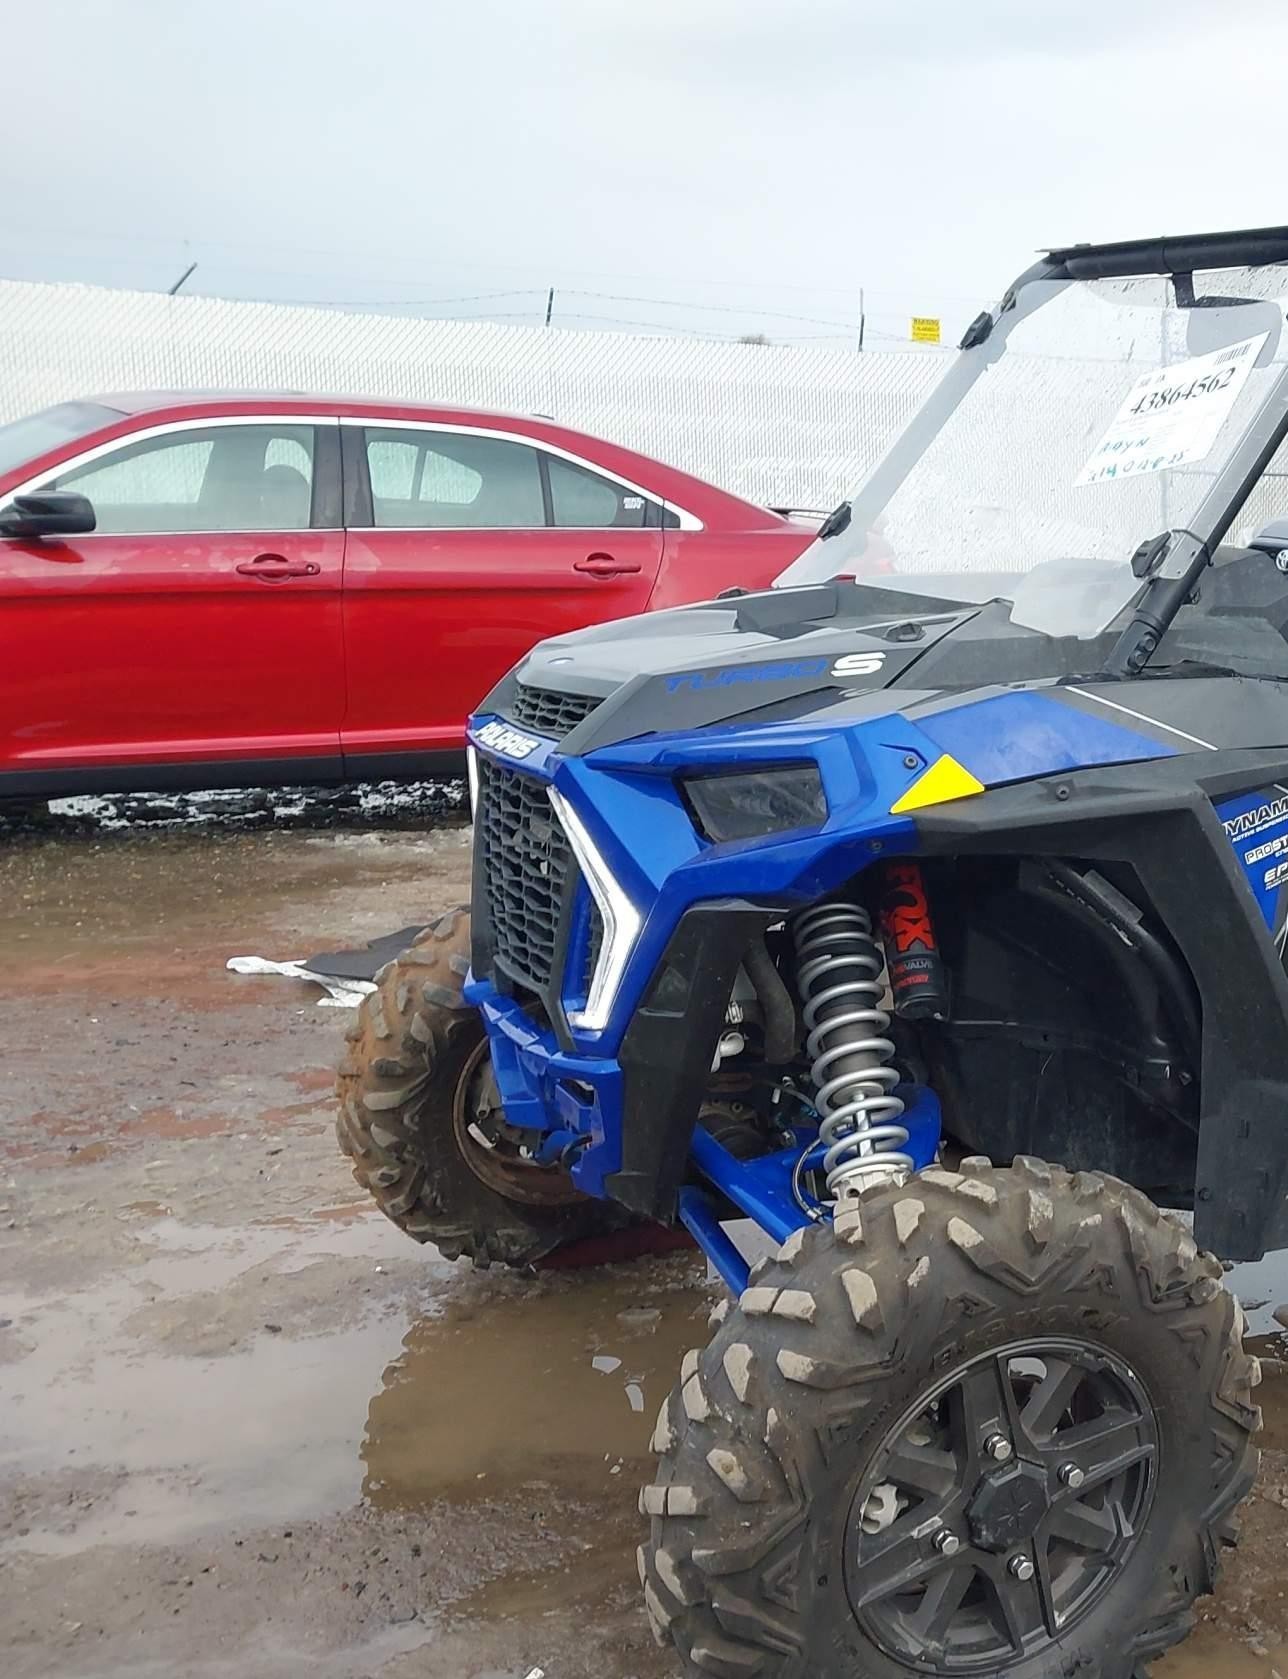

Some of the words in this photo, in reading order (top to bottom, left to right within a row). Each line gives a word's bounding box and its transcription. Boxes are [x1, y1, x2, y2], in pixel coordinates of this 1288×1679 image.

[1130, 366, 1236, 415] 43864562
[665, 658, 828, 694] TURBO
[830, 651, 887, 677] S
[474, 721, 540, 758] POLARIS
